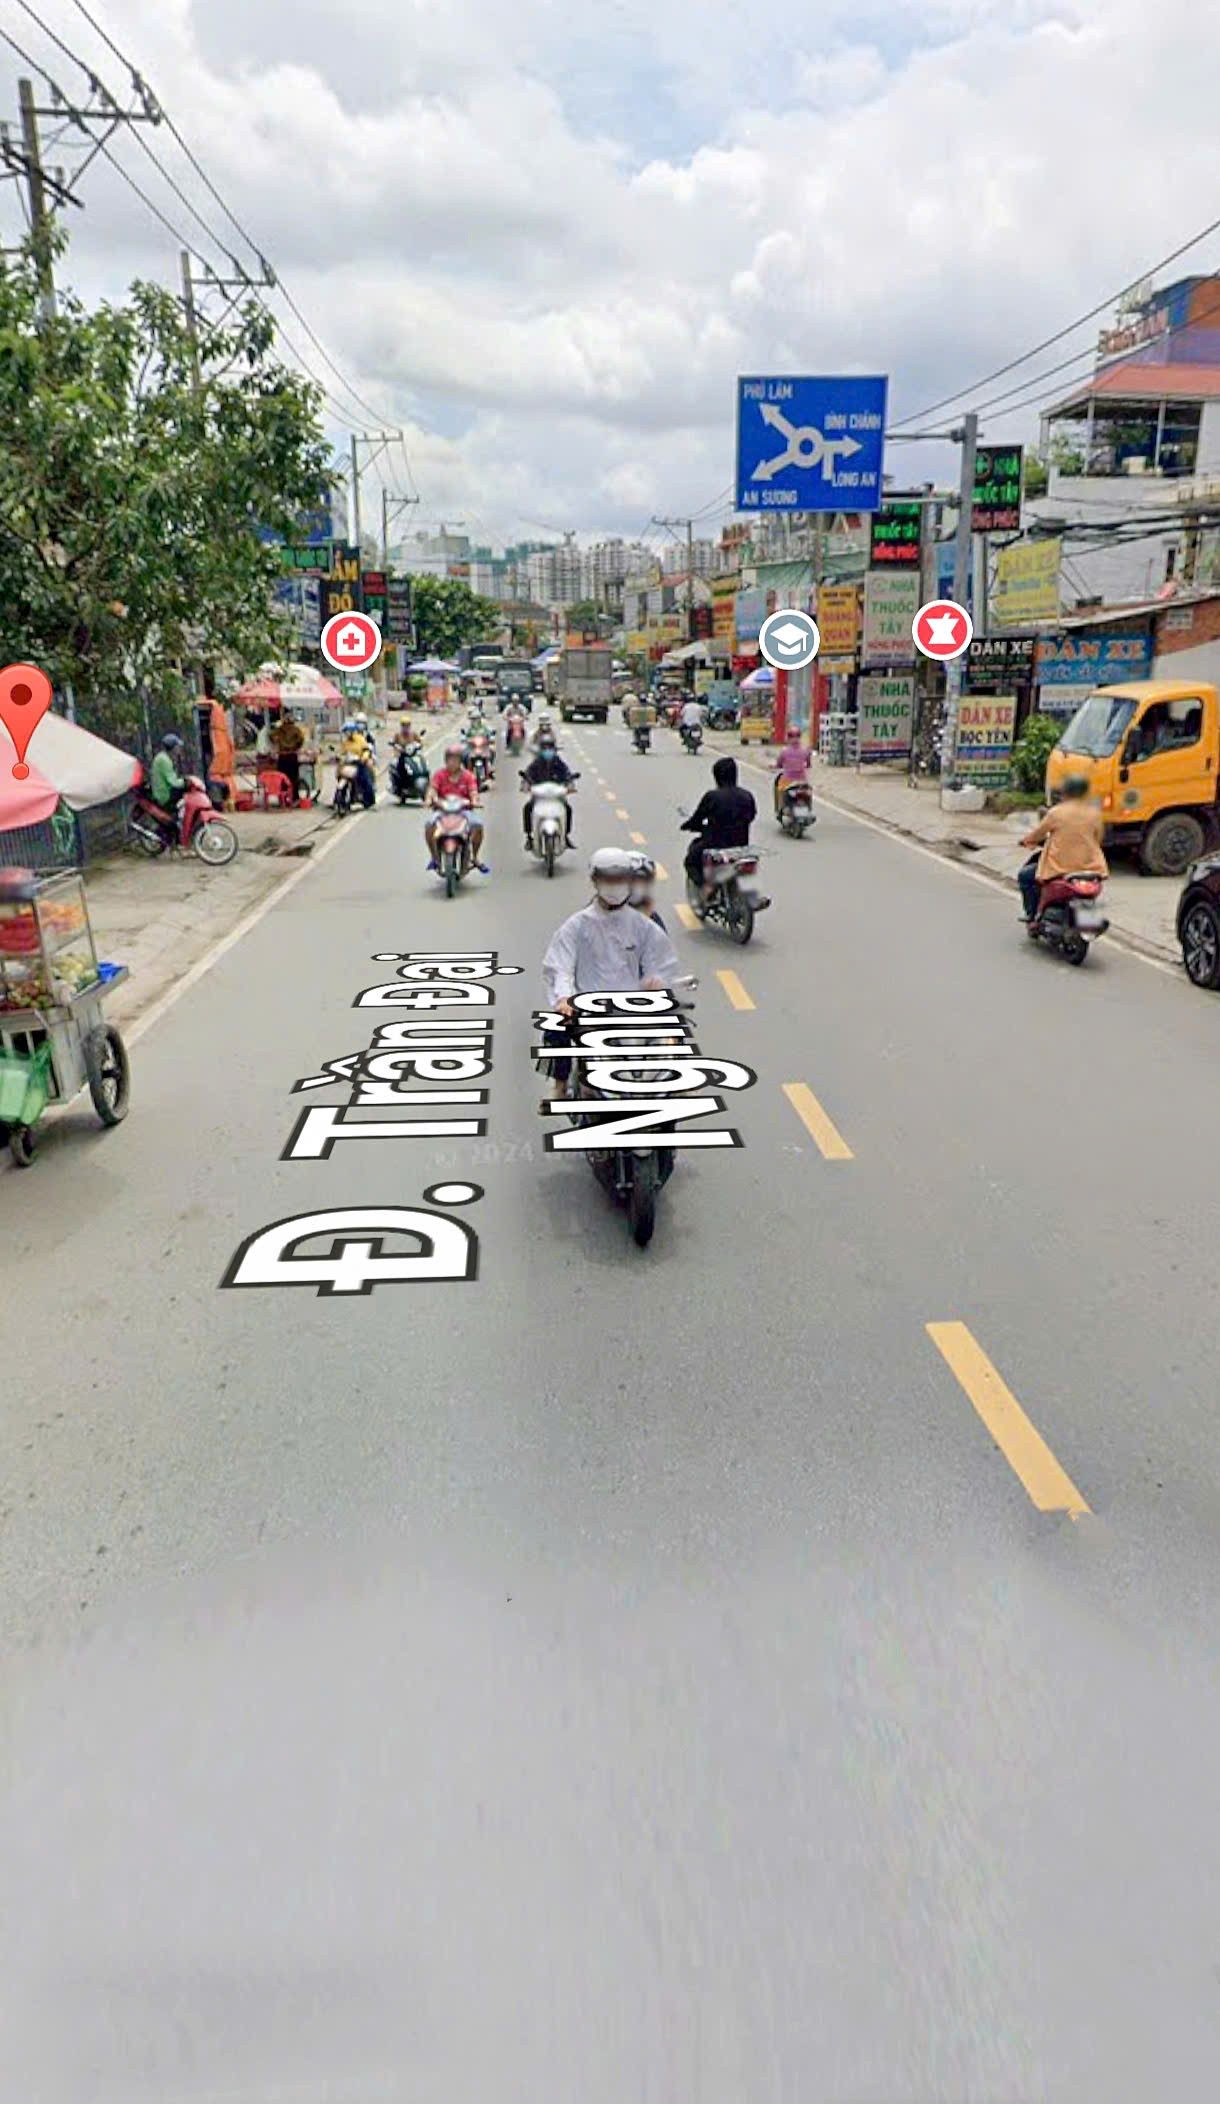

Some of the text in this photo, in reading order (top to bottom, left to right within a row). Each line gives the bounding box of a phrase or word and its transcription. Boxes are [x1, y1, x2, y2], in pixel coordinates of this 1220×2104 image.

[831, 472, 878, 487] LONG AN
[742, 489, 759, 506] AN
[872, 598, 914, 614] THUỐC
[879, 617, 903, 635] TÂY
[1009, 640, 1034, 655] XE
[1105, 640, 1146, 660] XE
[863, 699, 911, 718] THUỐC
[995, 707, 1012, 725] XE
[872, 722, 898, 738] TÂY
